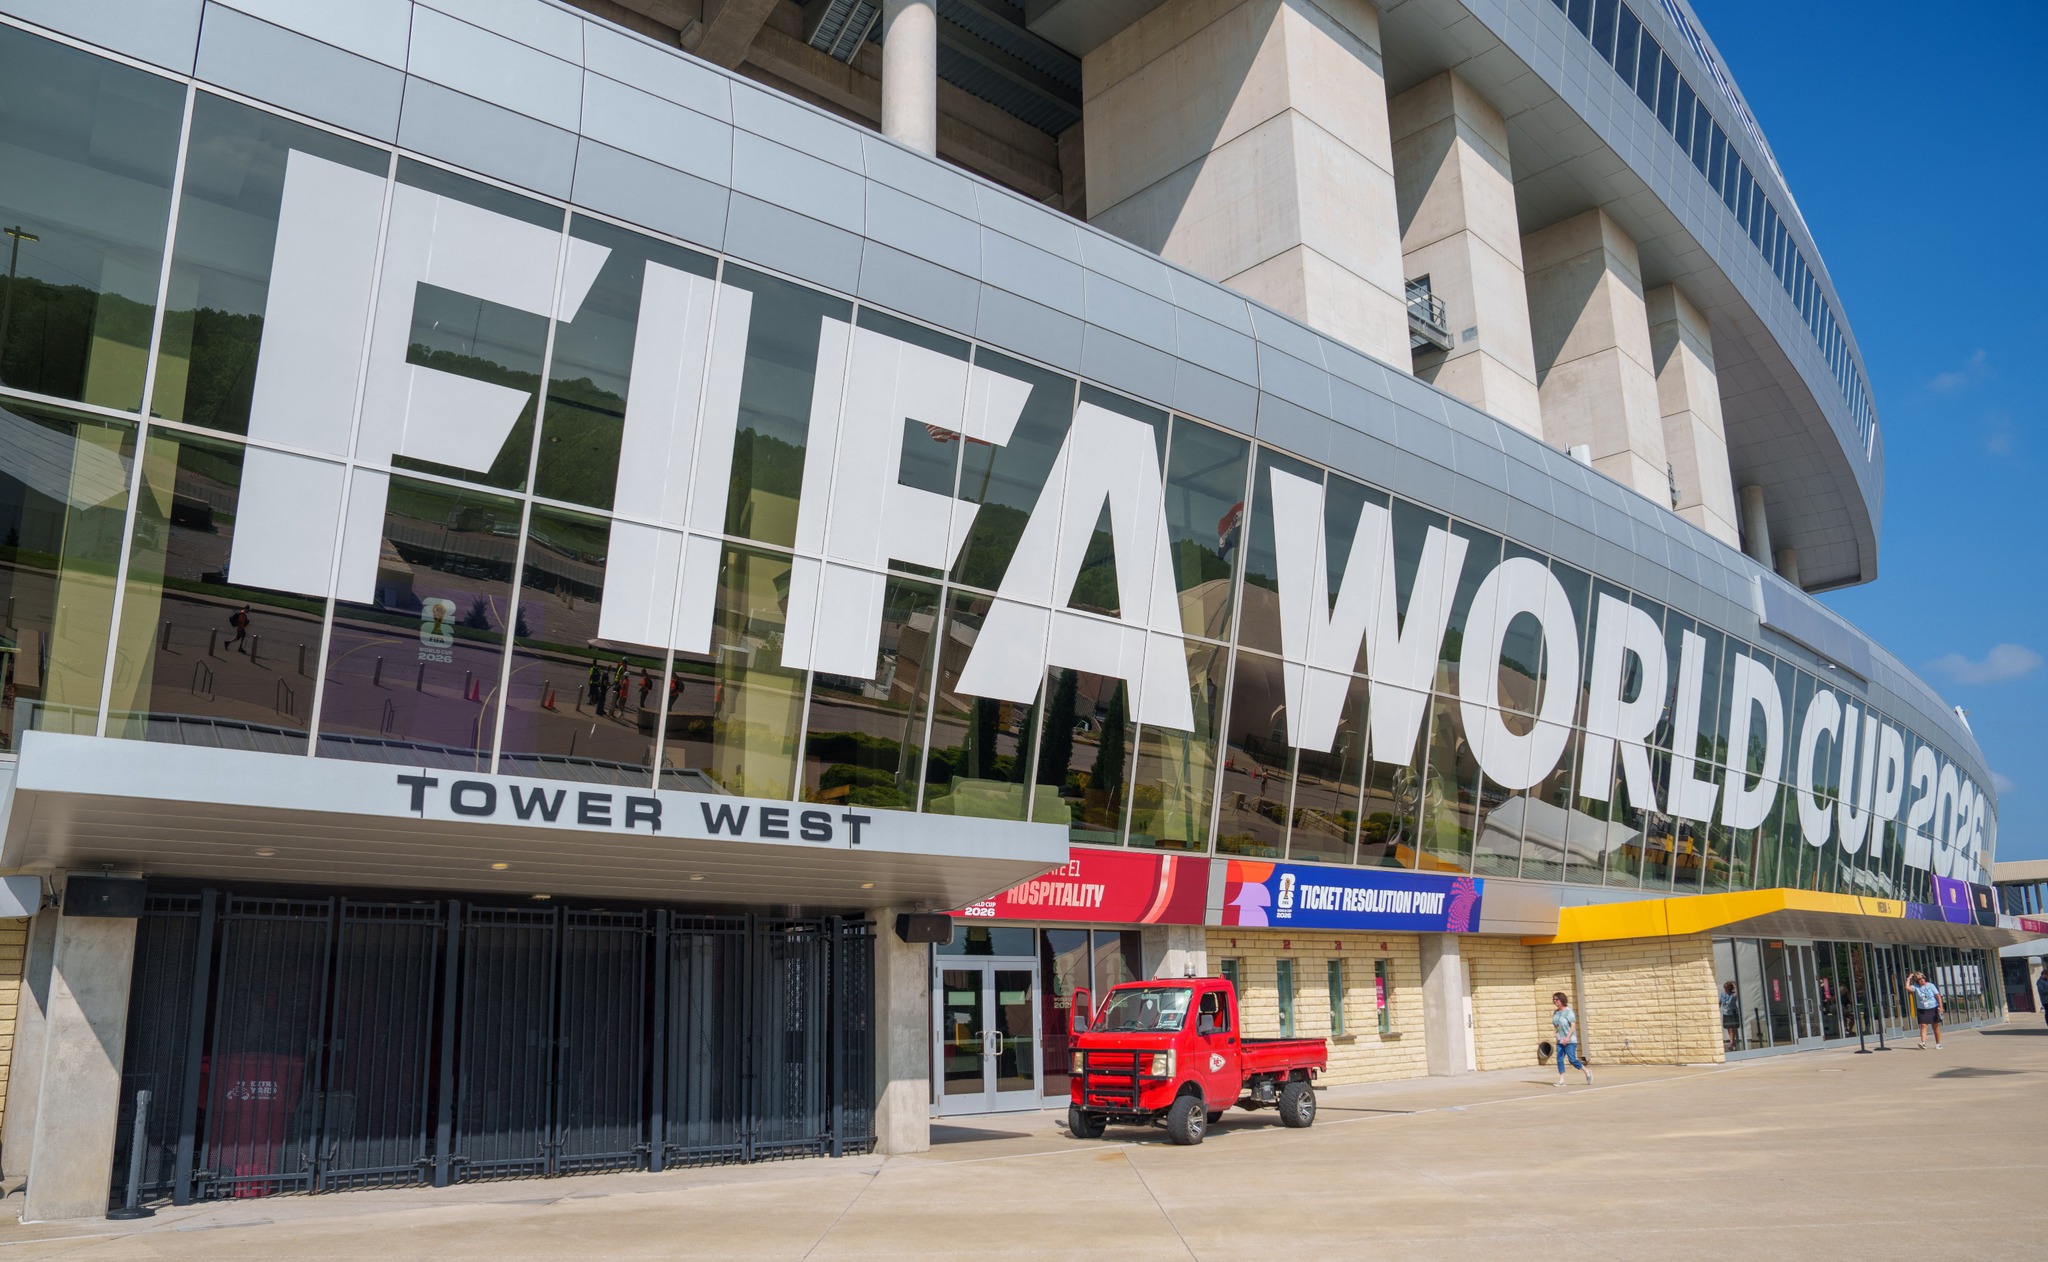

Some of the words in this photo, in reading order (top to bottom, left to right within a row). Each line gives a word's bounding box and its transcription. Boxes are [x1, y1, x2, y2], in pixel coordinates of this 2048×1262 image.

[228, 148, 1195, 732] FIFA
[1270, 466, 1784, 830] WORLD
[1797, 690, 1905, 859] CUP
[1904, 745, 1985, 883] 2026
[418, 653, 453, 663] 2026
[397, 774, 662, 831] TOWER
[700, 802, 871, 845] WEST
[1068, 860, 1081, 877] E1
[1006, 880, 1105, 908] HOSPITALITY
[1300, 884, 1343, 911] TICKET
[1342, 887, 1413, 915] RESOLUTION
[1411, 891, 1446, 915] POINT
[964, 907, 996, 917] 2026
[1230, 938, 1237, 948] 1
[1283, 939, 1291, 949] 2
[1335, 940, 1342, 950] 3
[1380, 942, 1388, 951] 4
